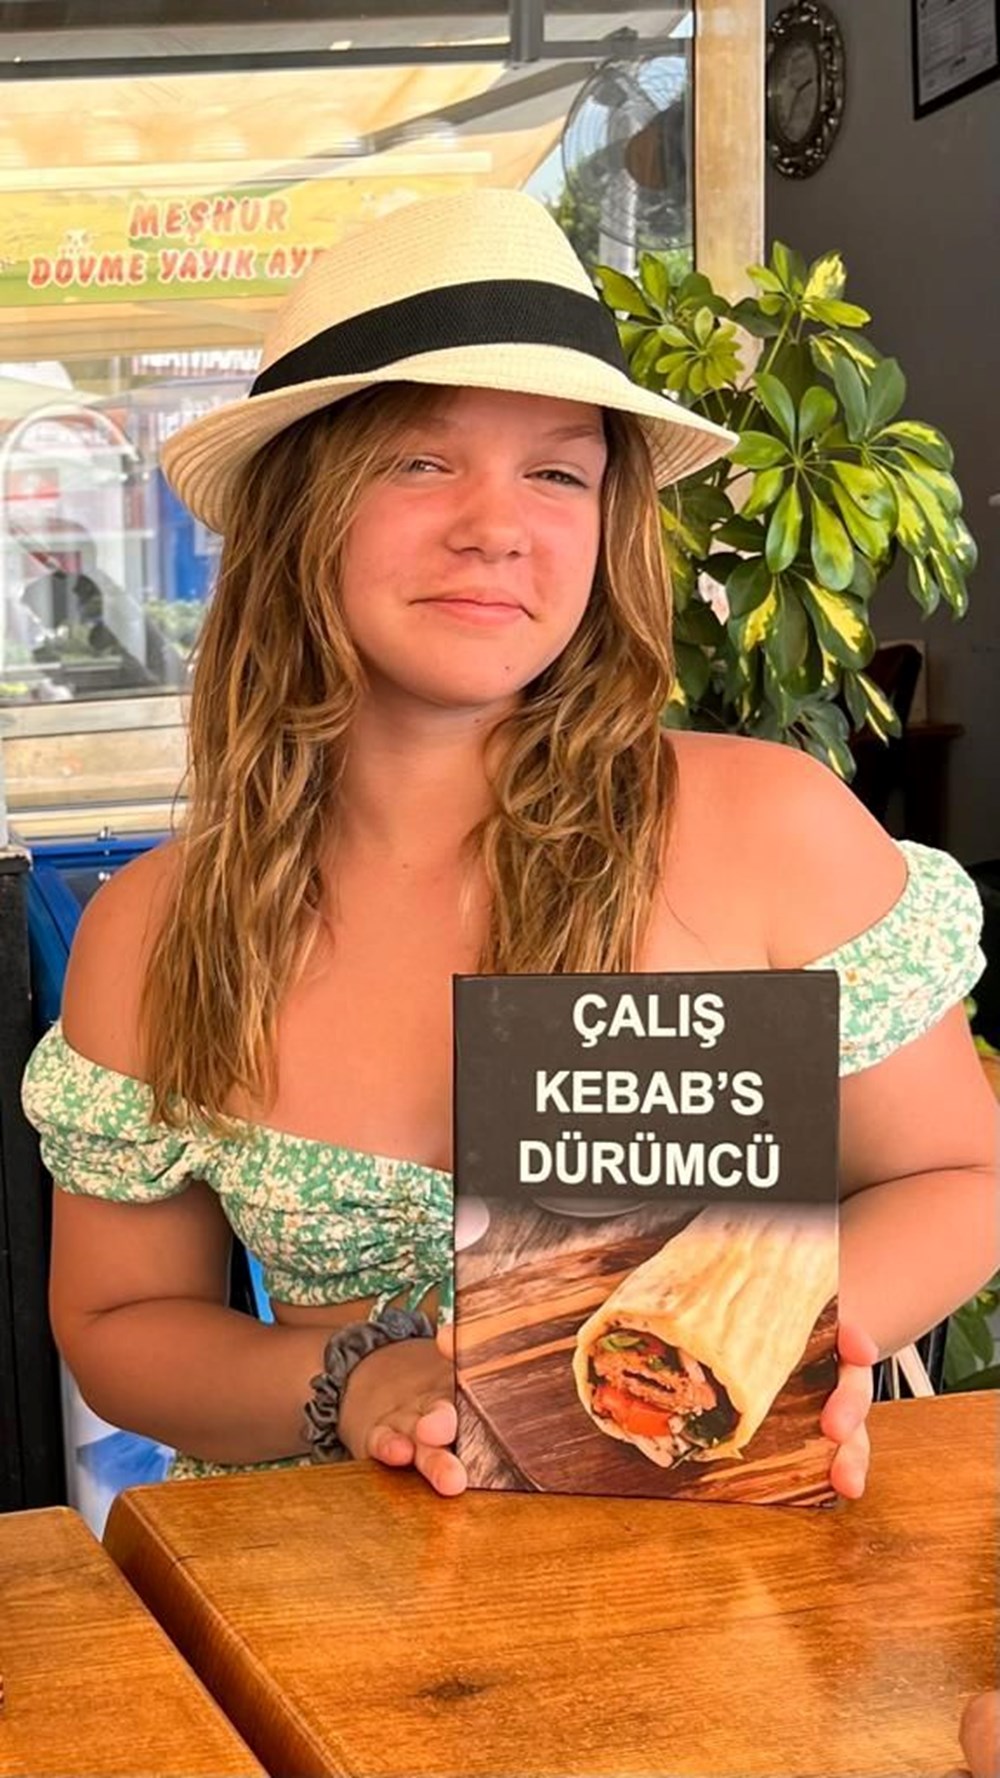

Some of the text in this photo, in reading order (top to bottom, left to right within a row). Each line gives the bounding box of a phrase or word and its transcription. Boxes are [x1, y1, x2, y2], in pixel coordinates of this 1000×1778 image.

[129, 199, 288, 244] MEŞHUR
[160, 249, 256, 281] YAYIK
[572, 993, 725, 1048] ÇALIŞ
[535, 1070, 765, 1116] KEBAB’S
[518, 1132, 780, 1188] DÜRÜMCÜ
